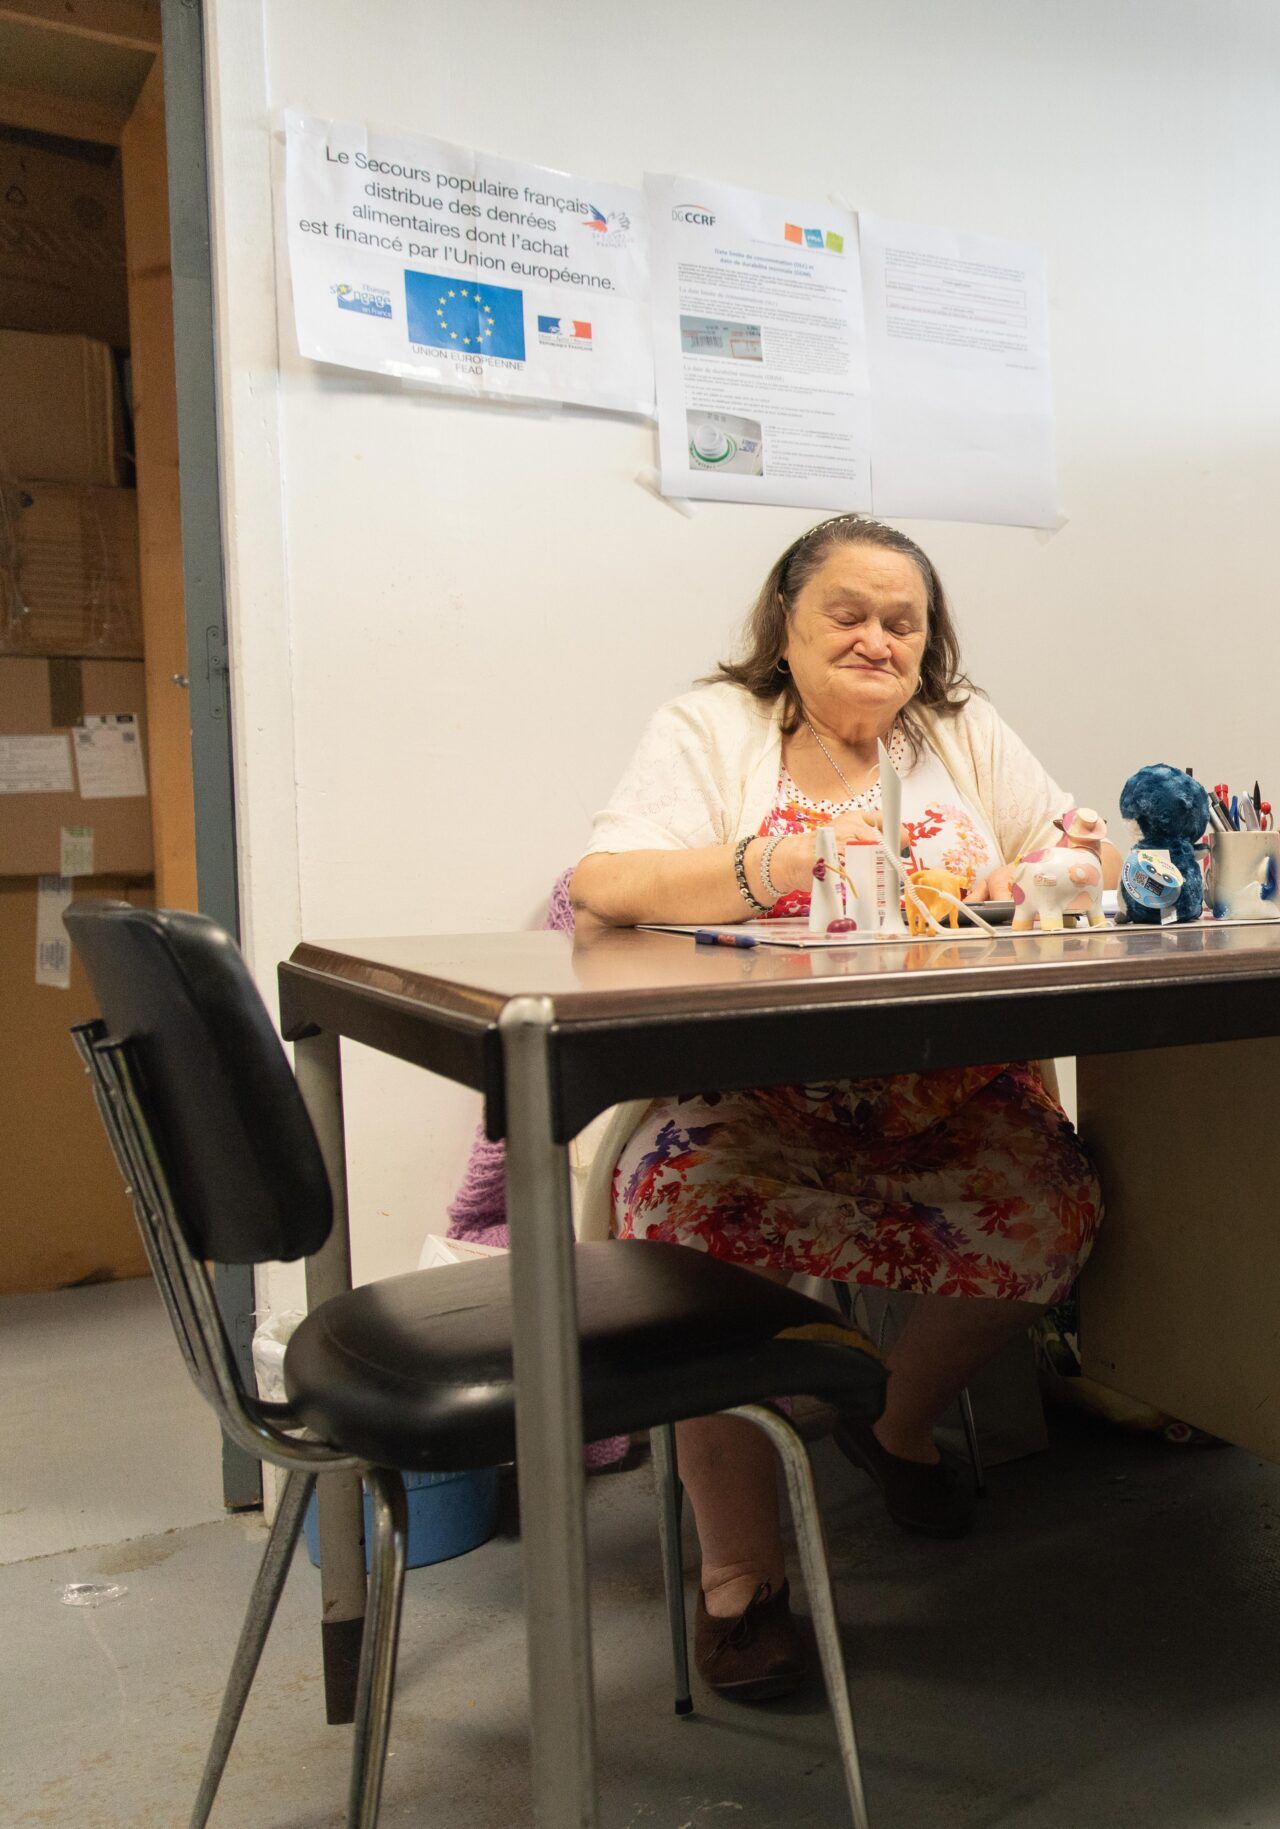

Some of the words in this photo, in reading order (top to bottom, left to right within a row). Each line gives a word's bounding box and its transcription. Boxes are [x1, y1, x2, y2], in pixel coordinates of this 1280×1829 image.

[325, 145, 350, 165] Le
[354, 152, 432, 183] Secours
[436, 173, 519, 200] populaire
[524, 187, 590, 216] français
[364, 182, 444, 211] distribue
[448, 200, 482, 217] des
[486, 206, 557, 232] denrées
[299, 219, 329, 237] est
[334, 222, 403, 252] financé
[408, 242, 440, 259] par
[444, 246, 506, 271] l'Union
[511, 261, 616, 291] européenne.
[352, 203, 461, 239] alimentaires
[465, 226, 507, 248] dont
[511, 233, 570, 259] l'achat
[411, 345, 448, 360] UNION
